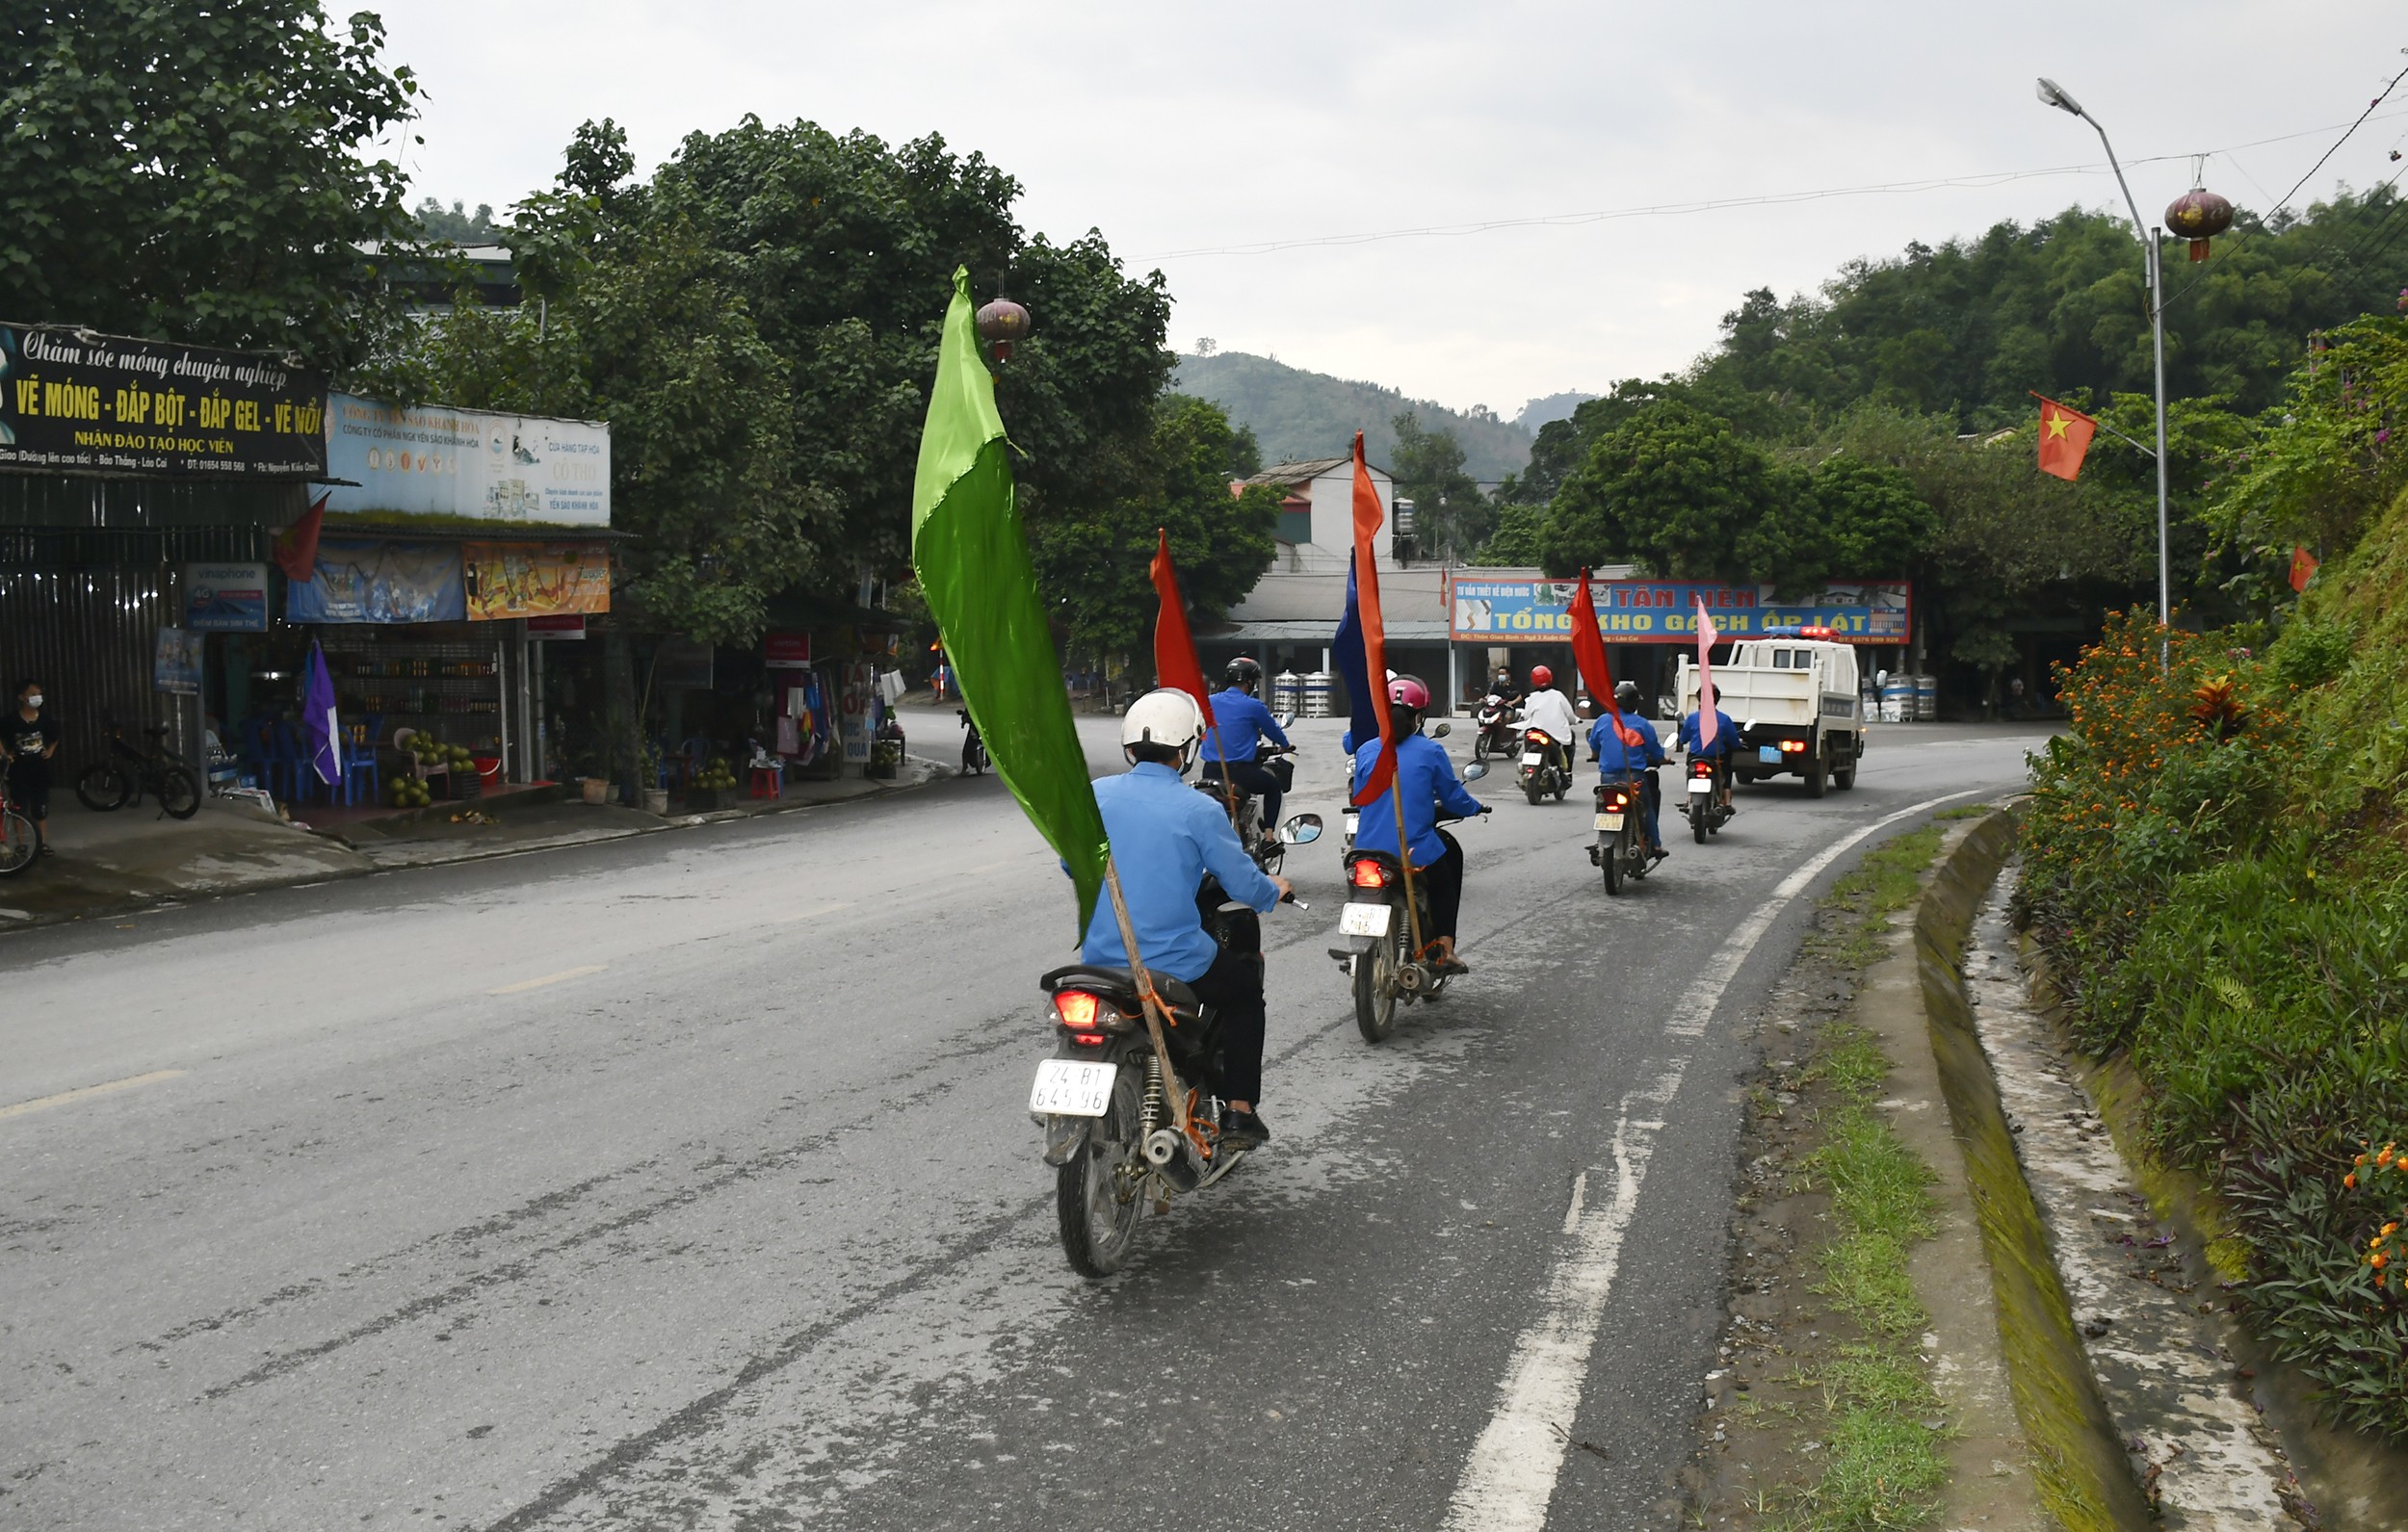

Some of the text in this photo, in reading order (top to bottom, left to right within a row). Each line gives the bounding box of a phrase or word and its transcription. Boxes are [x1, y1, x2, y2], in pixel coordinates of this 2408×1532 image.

[23, 330, 287, 392] Chăm sóc móng chuyên nghiệp
[16, 374, 39, 415] VẼ
[45, 377, 99, 419] MÓNG
[117, 379, 150, 425] ĐẮP
[155, 387, 185, 432] BỘT
[199, 387, 230, 428] ĐẮP
[235, 400, 261, 431] GEL
[275, 399, 292, 433] VẼ
[295, 397, 322, 434] NỔI
[75, 429, 234, 455] NHẬN ĐÀO TẠO HỌC VIÊN
[156, 457, 168, 468] Cai
[198, 568, 255, 580] vinaphone
[195, 588, 210, 599] 4G
[1614, 585, 1755, 609] TÂN LIÊN
[1495, 607, 1572, 630] TỔNG
[1598, 614, 1653, 631] KHO
